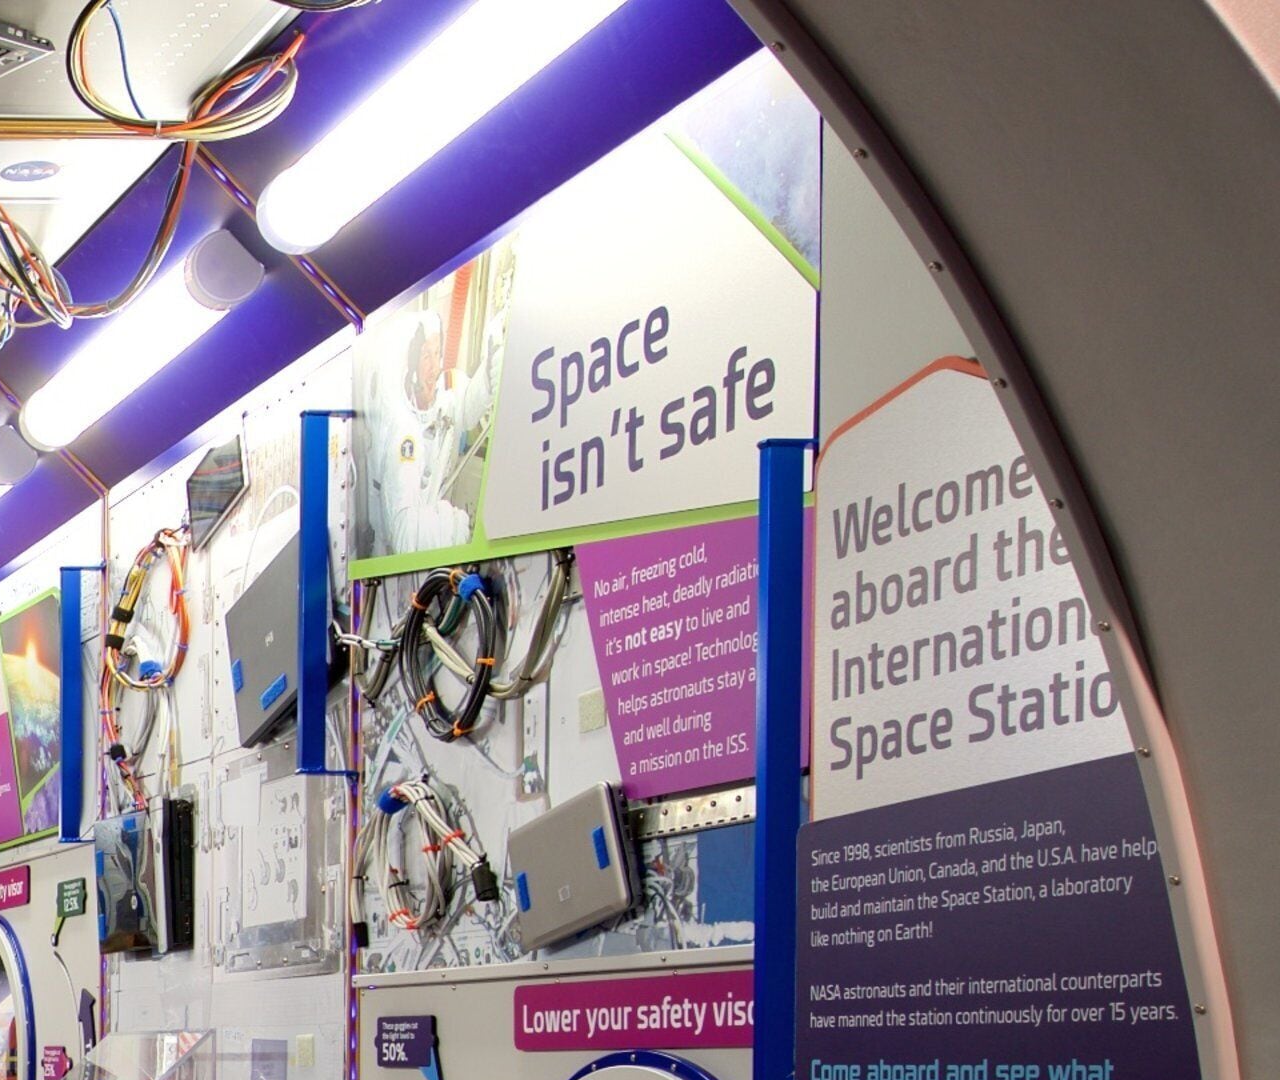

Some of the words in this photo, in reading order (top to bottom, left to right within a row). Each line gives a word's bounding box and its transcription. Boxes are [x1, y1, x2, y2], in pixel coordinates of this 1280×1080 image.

[530, 303, 670, 427] Space
[658, 345, 777, 462] safe
[832, 454, 1034, 560] Welcome
[594, 579, 610, 599] No
[611, 572, 629, 593] air,
[631, 557, 676, 586] freezing
[679, 542, 708, 567] cold,
[830, 532, 979, 631] aboard
[992, 516, 1072, 583] the
[599, 602, 640, 628] intense
[642, 591, 670, 614] heat,
[673, 576, 713, 606] deadly
[624, 628, 647, 651] not
[650, 617, 683, 645] easy
[686, 613, 698, 632] to
[701, 607, 723, 628] live
[726, 598, 750, 619] and
[611, 660, 639, 686] work
[642, 657, 653, 678] in
[654, 646, 692, 677] space!
[617, 695, 647, 716] helps
[650, 677, 715, 707] astronauts
[716, 668, 746, 690] stay
[624, 725, 644, 746] and
[645, 717, 670, 739] well
[673, 710, 712, 734] during
[829, 707, 953, 781] Space
[967, 660, 1119, 743] Statio
[630, 759, 637, 776] a
[639, 747, 682, 774] mission
[684, 745, 700, 763] on
[702, 737, 723, 759] the
[726, 732, 749, 754] ISS.
[811, 850, 840, 866] Since
[843, 843, 872, 861] 1998,
[875, 836, 932, 858] scientists
[935, 832, 966, 849] from
[969, 823, 1017, 845] Russia,
[1021, 820, 1065, 841] Japan,
[811, 877, 829, 893] the
[832, 872, 885, 892] European
[889, 866, 926, 884] Union,
[929, 859, 978, 880] Canada,
[981, 854, 1006, 873] and
[1010, 851, 1033, 870] the
[1081, 843, 1117, 862] have
[1122, 836, 1157, 860] help
[8, 879, 23, 897] visor
[811, 902, 838, 920] build
[840, 899, 861, 917] and
[863, 894, 915, 915] maintain
[917, 892, 938, 910] the
[941, 889, 980, 911] Space
[983, 883, 1036, 904] Station,
[1039, 884, 1048, 898] a
[1051, 875, 1133, 897] laboratory
[811, 930, 829, 947] like
[831, 926, 874, 948] nothing
[877, 927, 892, 941] on
[895, 921, 933, 941] Earth!
[810, 984, 841, 1001] NASA
[843, 982, 906, 1000] astronauts
[908, 979, 931, 997] and
[935, 977, 965, 996] their
[968, 973, 1057, 994] international
[1060, 970, 1162, 994] counterparts
[523, 1004, 581, 1034] Lower
[586, 1005, 632, 1038] your
[637, 996, 707, 1035] safety
[810, 1012, 835, 1029] have
[838, 1010, 883, 1028] manned
[886, 1009, 906, 1027] the
[909, 1008, 953, 1026] station
[955, 1005, 1043, 1027] continuously
[1046, 1004, 1068, 1023] for
[1071, 1006, 1105, 1022] over
[1109, 1002, 1125, 1021] 15
[1130, 1004, 1179, 1025] years.
[382, 1043, 408, 1061] 50%.
